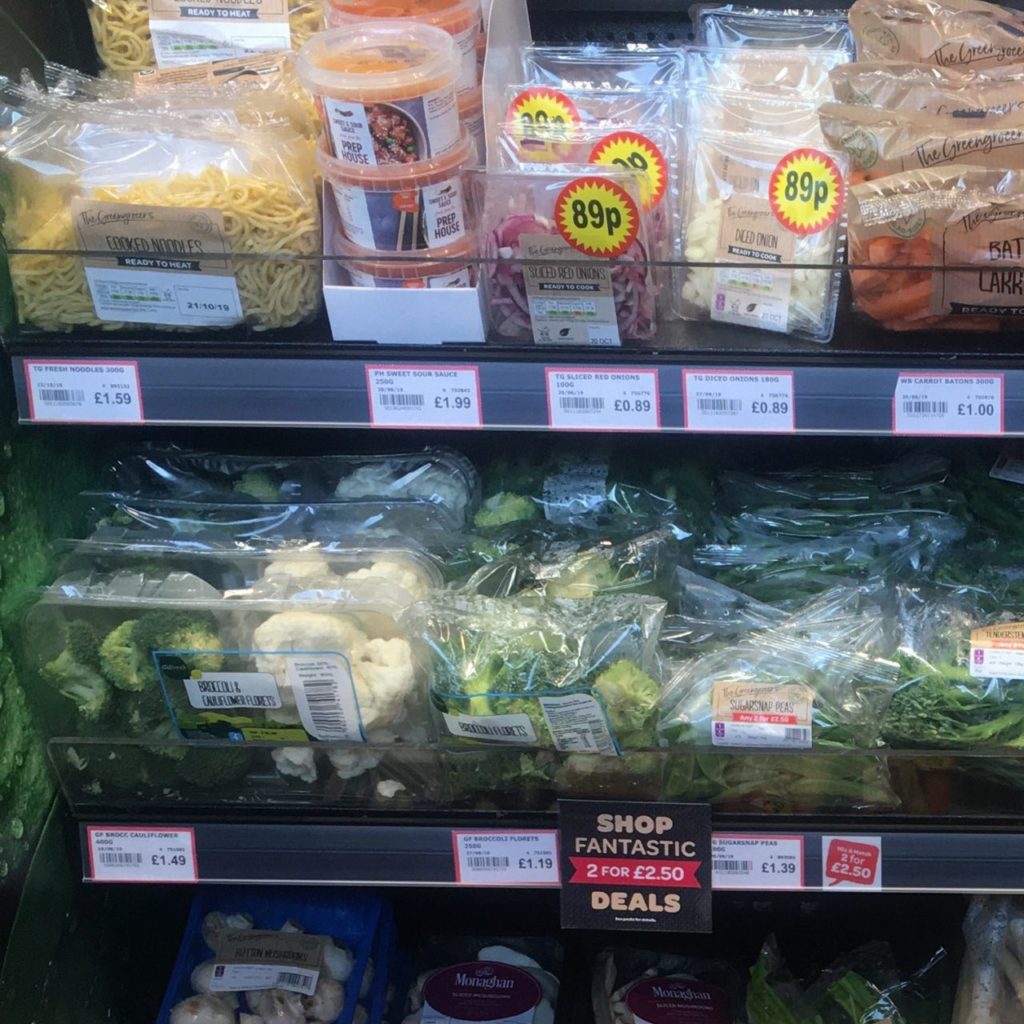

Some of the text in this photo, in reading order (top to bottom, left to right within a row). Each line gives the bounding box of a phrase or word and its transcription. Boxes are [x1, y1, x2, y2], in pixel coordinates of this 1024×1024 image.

[187, 8, 250, 18] READY TO HEAT
[342, 140, 362, 152] PREP
[342, 151, 369, 164] HOUSE
[784, 171, 828, 210] 89p
[436, 213, 456, 227] PREP
[571, 199, 622, 235] 89p
[434, 224, 460, 239] HOUSE
[735, 228, 778, 249] DICED ONION
[152, 238, 202, 254] NOODLES
[125, 258, 192, 269] READY TO HEAT
[528, 265, 606, 280] SLICED RED ONIONS
[95, 392, 131, 404] £1.59
[434, 397, 471, 408] £1.99
[614, 400, 650, 412] £0.89
[752, 402, 788, 414] £0.89
[958, 404, 994, 416] £1.00
[730, 699, 794, 714] SUGARSNAP PEAS
[596, 813, 674, 834] SHOP
[574, 837, 696, 858] FANTASTIC
[152, 855, 185, 865] £1.49
[519, 858, 552, 868] £1.19
[841, 853, 865, 864] 2 for
[586, 864, 685, 881] 2 FOR £2.50
[762, 863, 795, 873] £1.39
[831, 862, 871, 878] £2.50
[590, 890, 681, 912] DEALS
[234, 948, 262, 960] BUTTON
[454, 972, 514, 992] Monaghan
[652, 986, 711, 1003] Monaghan
